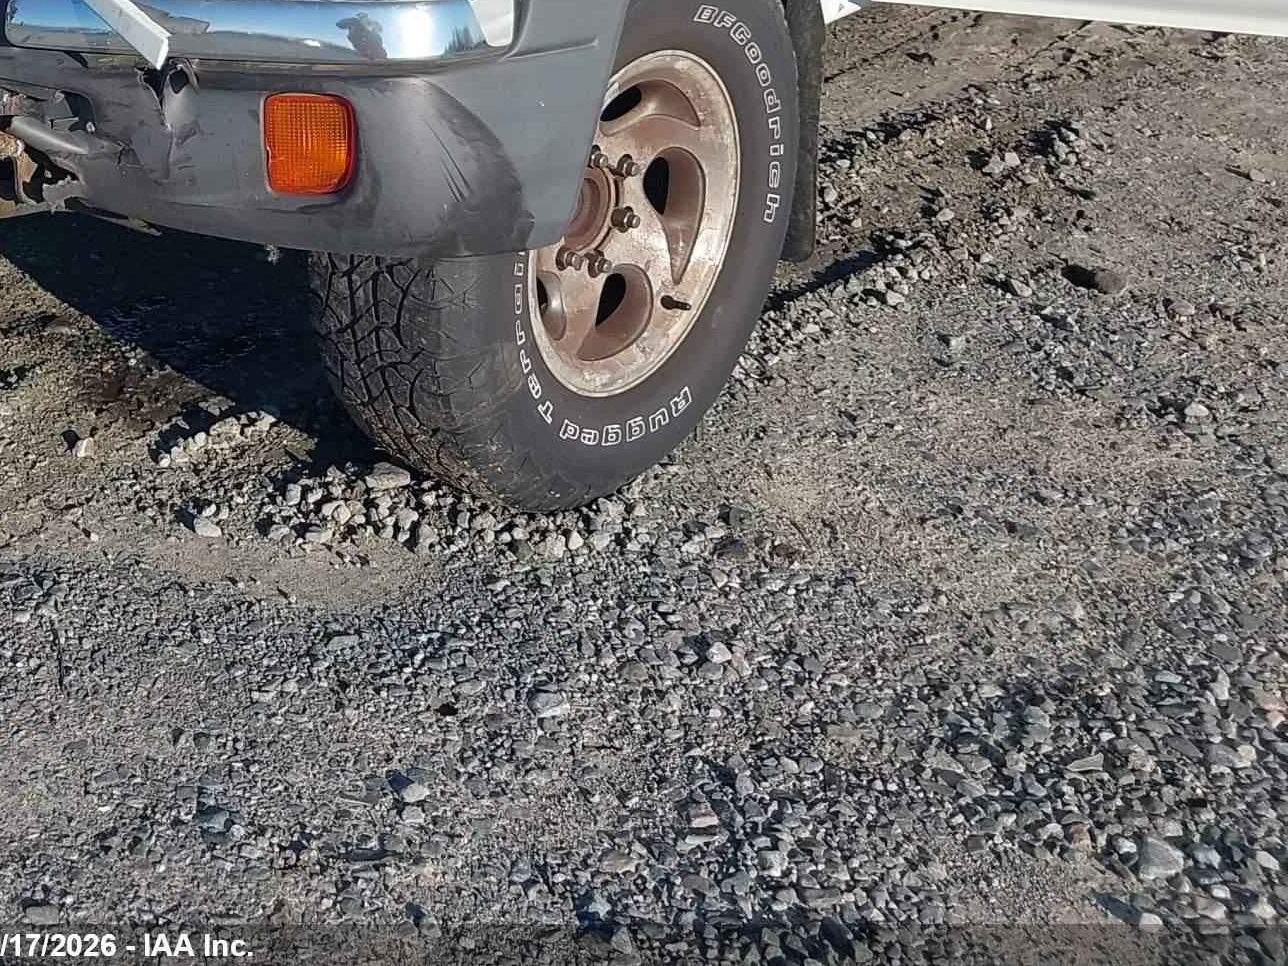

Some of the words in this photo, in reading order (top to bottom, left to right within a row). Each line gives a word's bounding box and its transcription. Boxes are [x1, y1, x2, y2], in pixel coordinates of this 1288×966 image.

[693, 4, 784, 223] BFGoodrich
[513, 250, 554, 425] Terrai
[559, 385, 692, 446] Rugged
